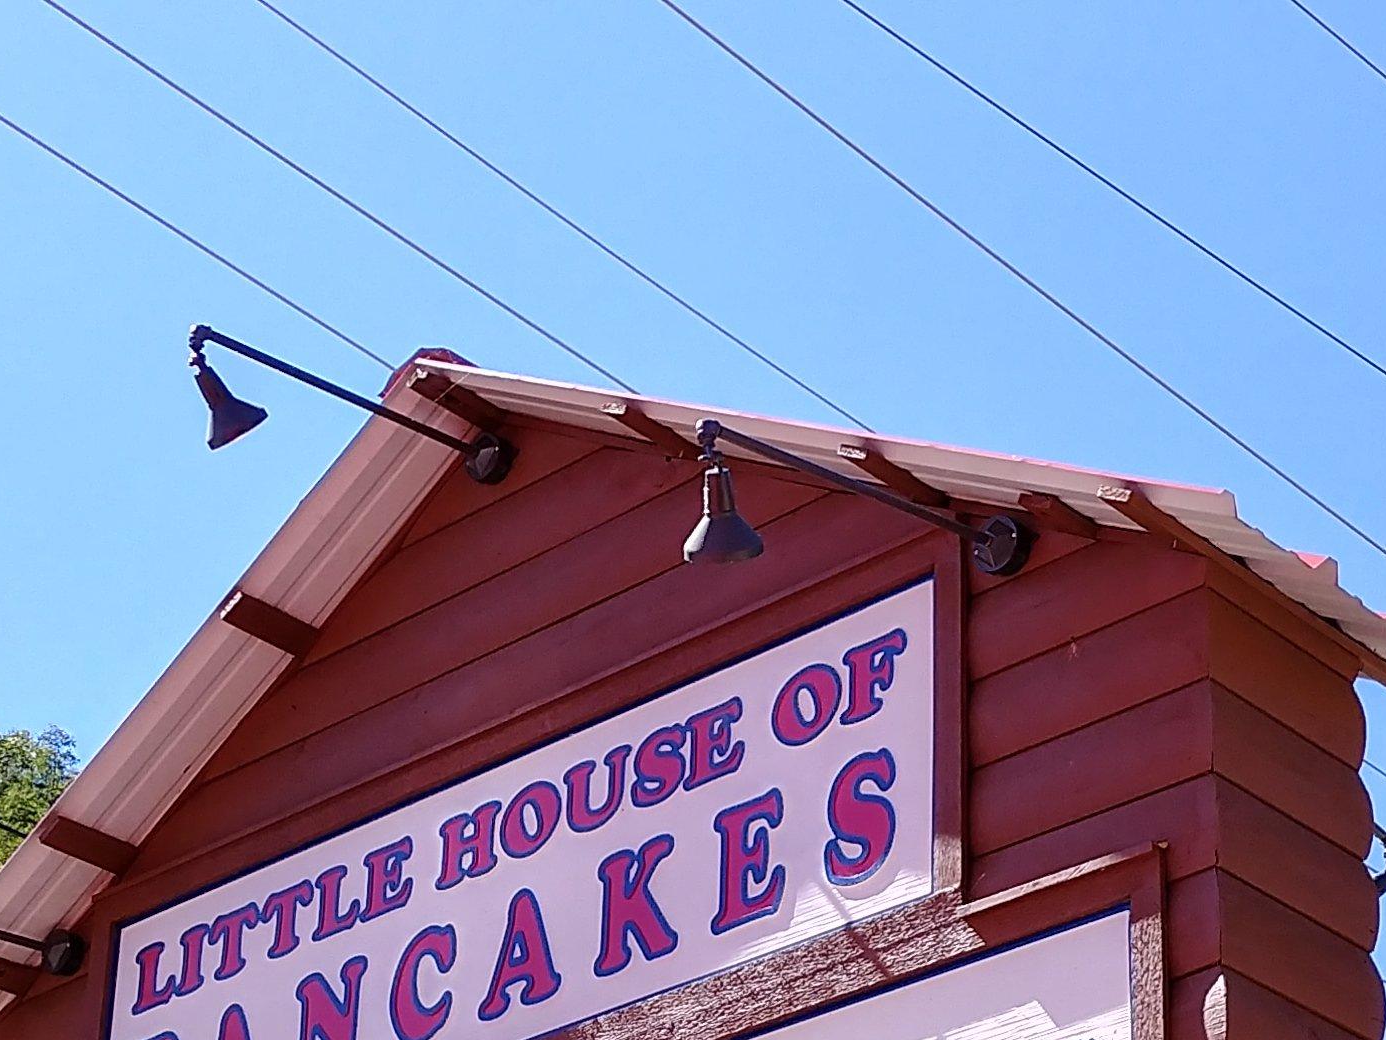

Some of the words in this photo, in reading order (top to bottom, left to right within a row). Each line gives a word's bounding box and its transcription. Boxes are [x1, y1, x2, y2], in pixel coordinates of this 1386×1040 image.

[131, 835, 414, 1016] LITTLE
[435, 696, 745, 890] HOUSE
[771, 628, 907, 746] OF
